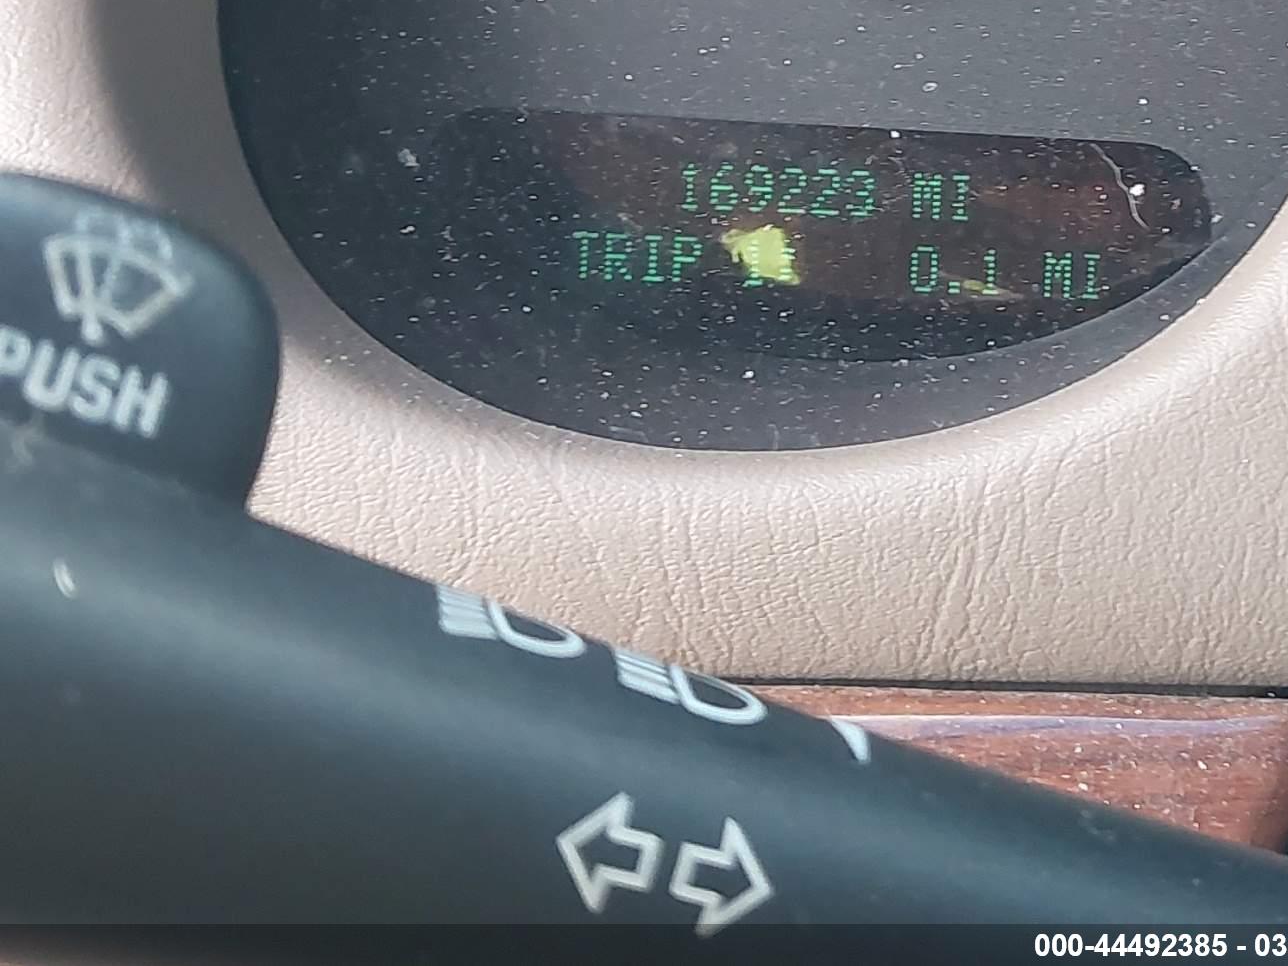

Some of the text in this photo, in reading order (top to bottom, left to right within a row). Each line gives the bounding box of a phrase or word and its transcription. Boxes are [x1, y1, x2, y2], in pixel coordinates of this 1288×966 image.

[680, 162, 971, 221] 169223 MI
[572, 230, 703, 283] TRIP
[910, 245, 1000, 296] 0.1
[1043, 250, 1101, 300] MI
